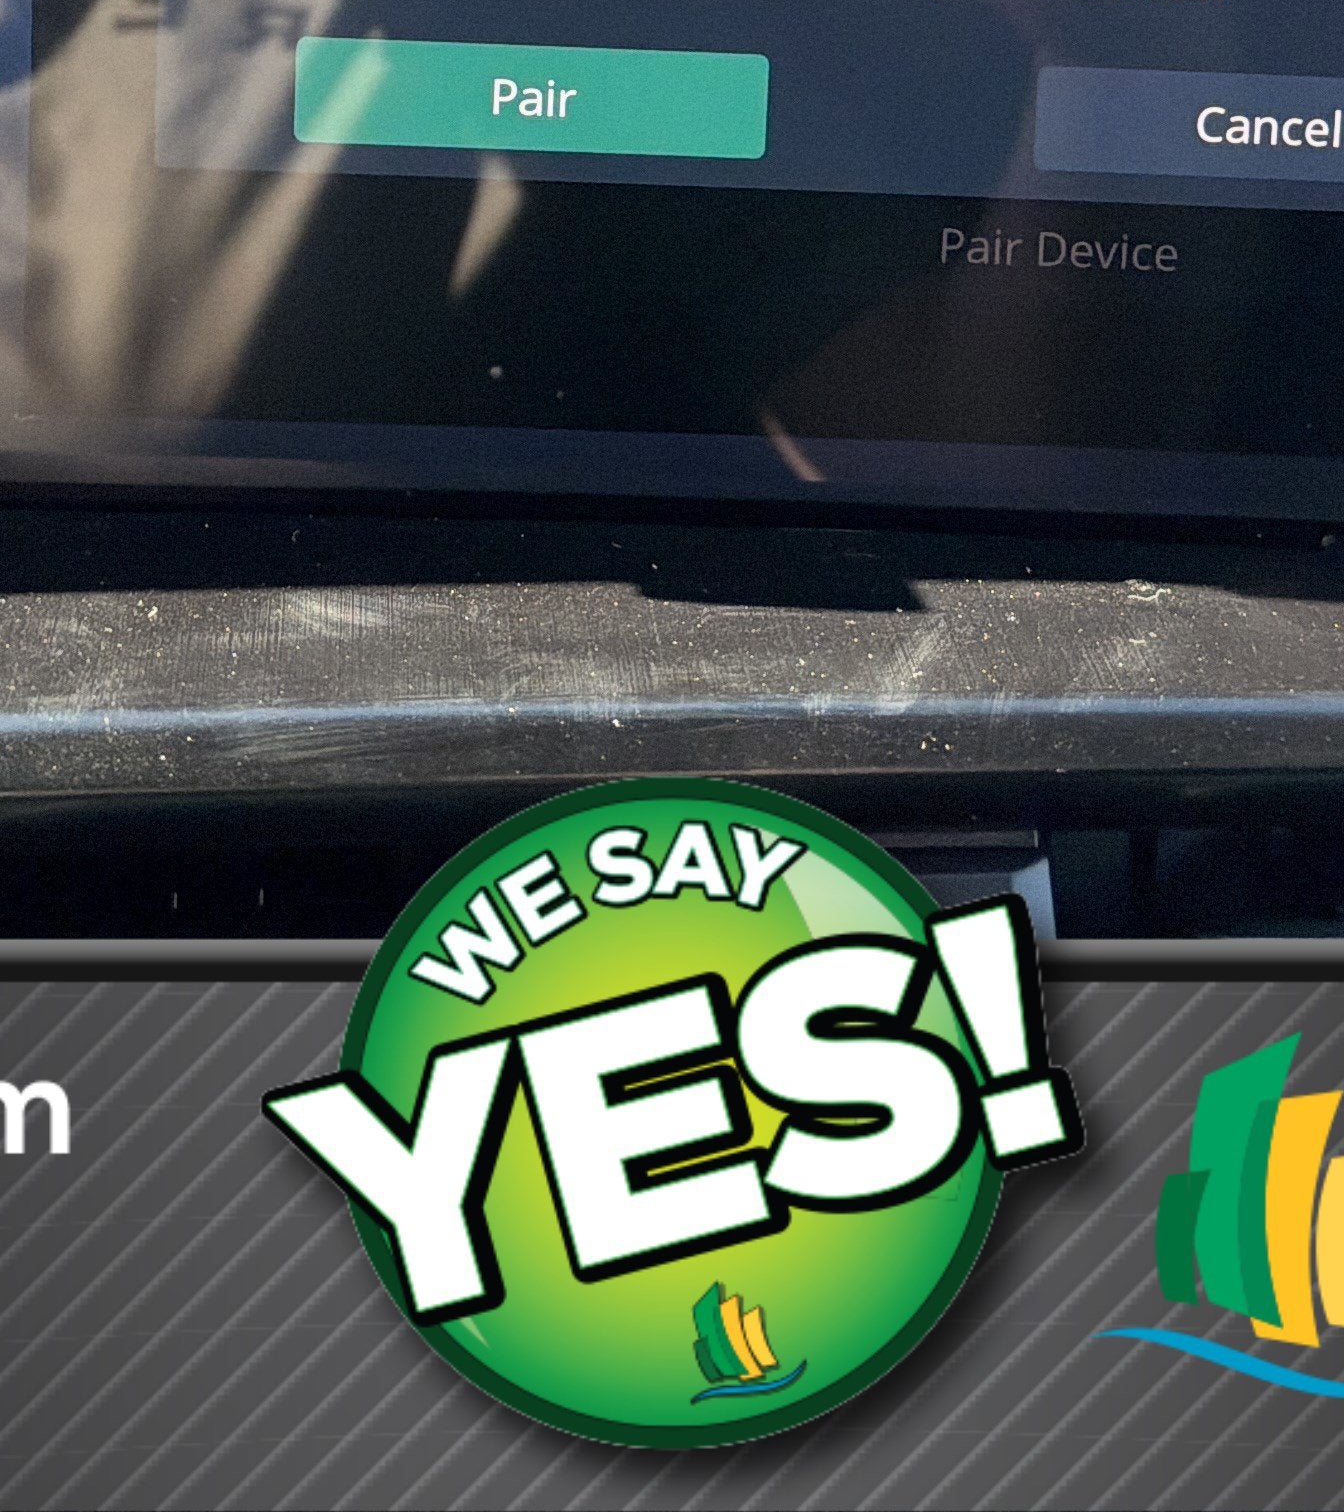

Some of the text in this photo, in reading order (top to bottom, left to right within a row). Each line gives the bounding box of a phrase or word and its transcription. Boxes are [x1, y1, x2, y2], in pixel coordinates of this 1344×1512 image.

[491, 77, 578, 119] Pair
[1196, 105, 1343, 149] Cancel
[940, 228, 1179, 273] Pair Device
